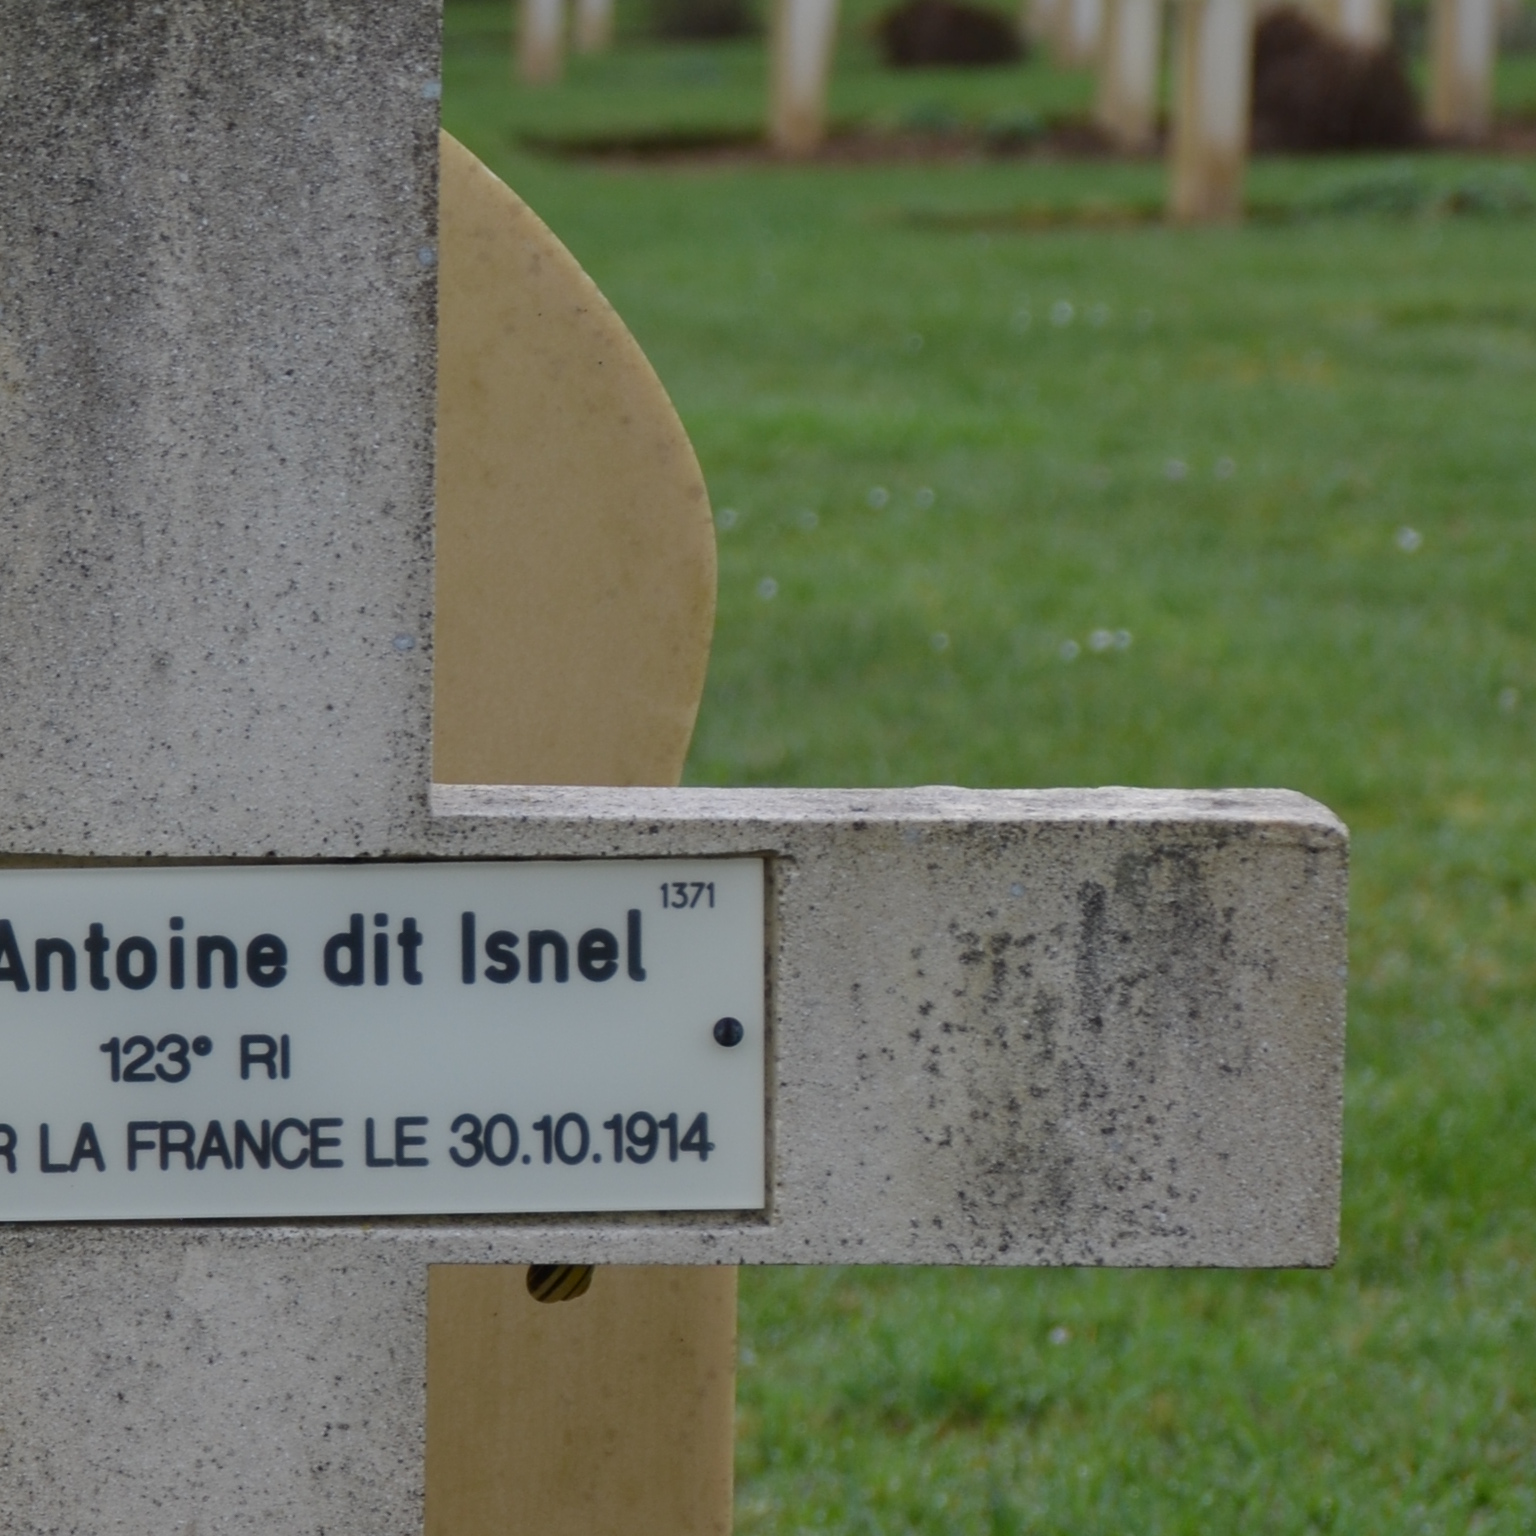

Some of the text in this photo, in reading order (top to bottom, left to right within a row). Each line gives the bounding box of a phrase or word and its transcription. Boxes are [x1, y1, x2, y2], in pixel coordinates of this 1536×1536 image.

[658, 880, 716, 910] 1371
[322, 911, 424, 988] dit
[460, 907, 648, 986] Isnel
[238, 1033, 291, 1081] RI
[38, 1121, 107, 1174] LA
[126, 1116, 345, 1173] FRANCE
[364, 1115, 430, 1169] LE
[447, 1110, 716, 1169] 30.10.1914
